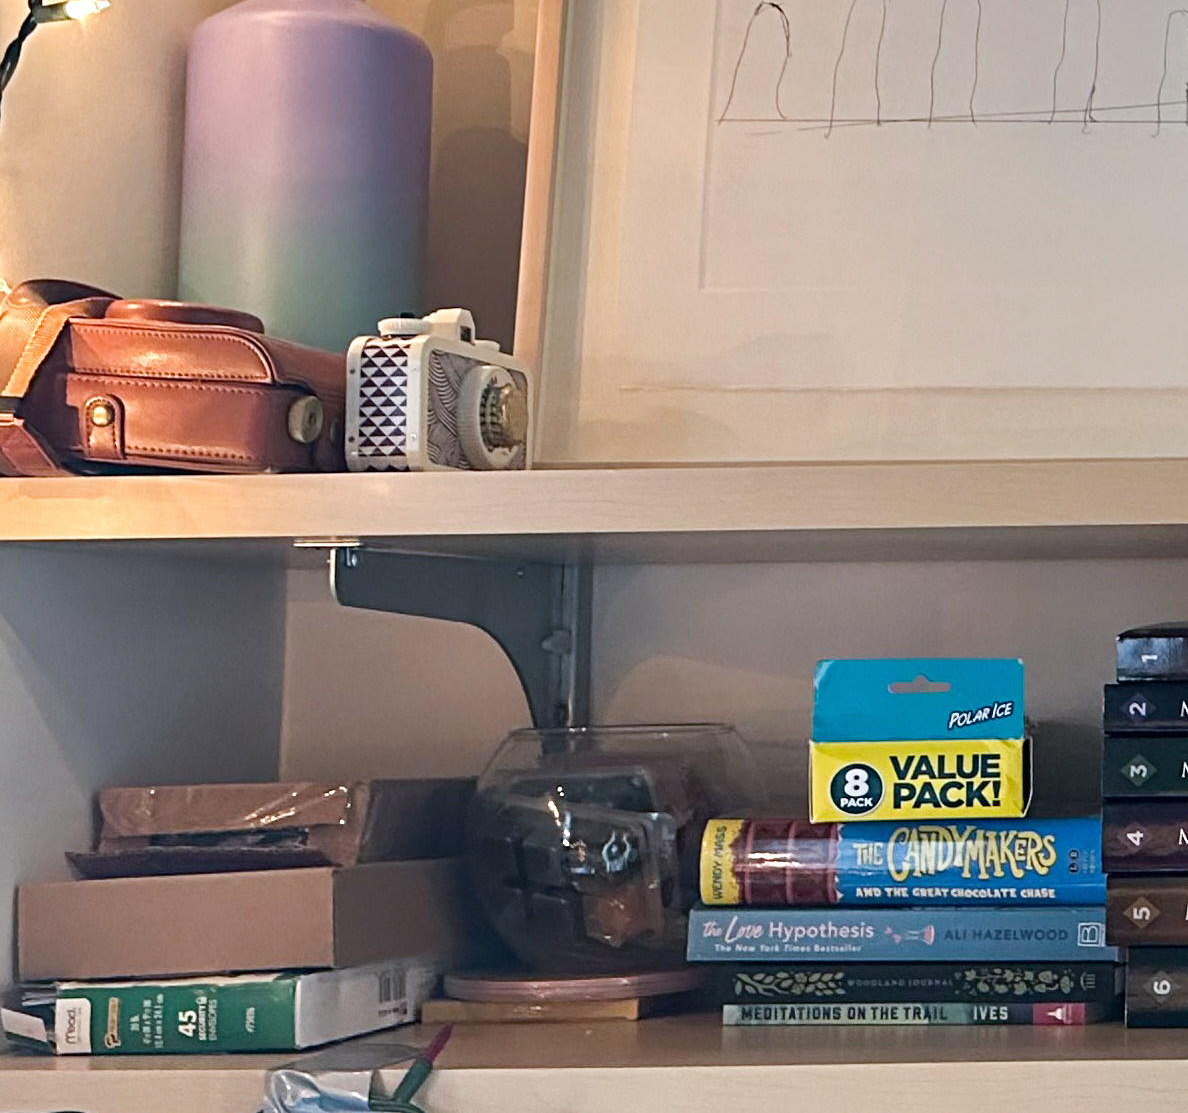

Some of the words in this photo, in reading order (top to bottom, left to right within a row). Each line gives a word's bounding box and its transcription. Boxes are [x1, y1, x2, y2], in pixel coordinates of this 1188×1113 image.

[1141, 654, 1158, 663] 1
[949, 707, 990, 730] POLAR
[992, 702, 1013, 719] ICE
[1128, 701, 1147, 717] 2
[889, 754, 1001, 780] VALUE
[1129, 764, 1148, 779] 3
[844, 768, 870, 797] 8
[840, 797, 873, 808] PACK
[893, 781, 1001, 809] PACK!
[714, 825, 727, 856] MASS
[1126, 830, 1144, 847] 4
[853, 843, 884, 866] THE
[886, 825, 1058, 882] CANDYMAKERS
[711, 860, 724, 900] WENDY
[856, 888, 882, 898] AND
[884, 887, 908, 898] THE
[912, 887, 950, 898] GREAT
[950, 887, 1017, 899] CHOCOLATE
[1020, 888, 1056, 899] CHASE
[1132, 906, 1150, 921] 5
[702, 920, 723, 938] the
[725, 915, 763, 944] Love
[768, 921, 875, 943] Hypothesis
[944, 929, 969, 941] ALI
[971, 929, 1069, 942] HAZELWOOD
[714, 943, 732, 953] The
[735, 943, 756, 953] New
[760, 943, 781, 953] York
[784, 943, 812, 953] Times
[813, 943, 862, 953] Bestseller
[846, 979, 905, 987] WOODLAND
[907, 978, 954, 987] JOURNAL
[1153, 979, 1171, 995] 6
[741, 1006, 842, 1021] MEDITATIONS
[847, 1006, 866, 1020] ON
[870, 1006, 899, 1020] THE
[902, 1006, 948, 1021] TRAIL
[973, 1006, 1009, 1021] IVES
[178, 1009, 197, 1038] 45
